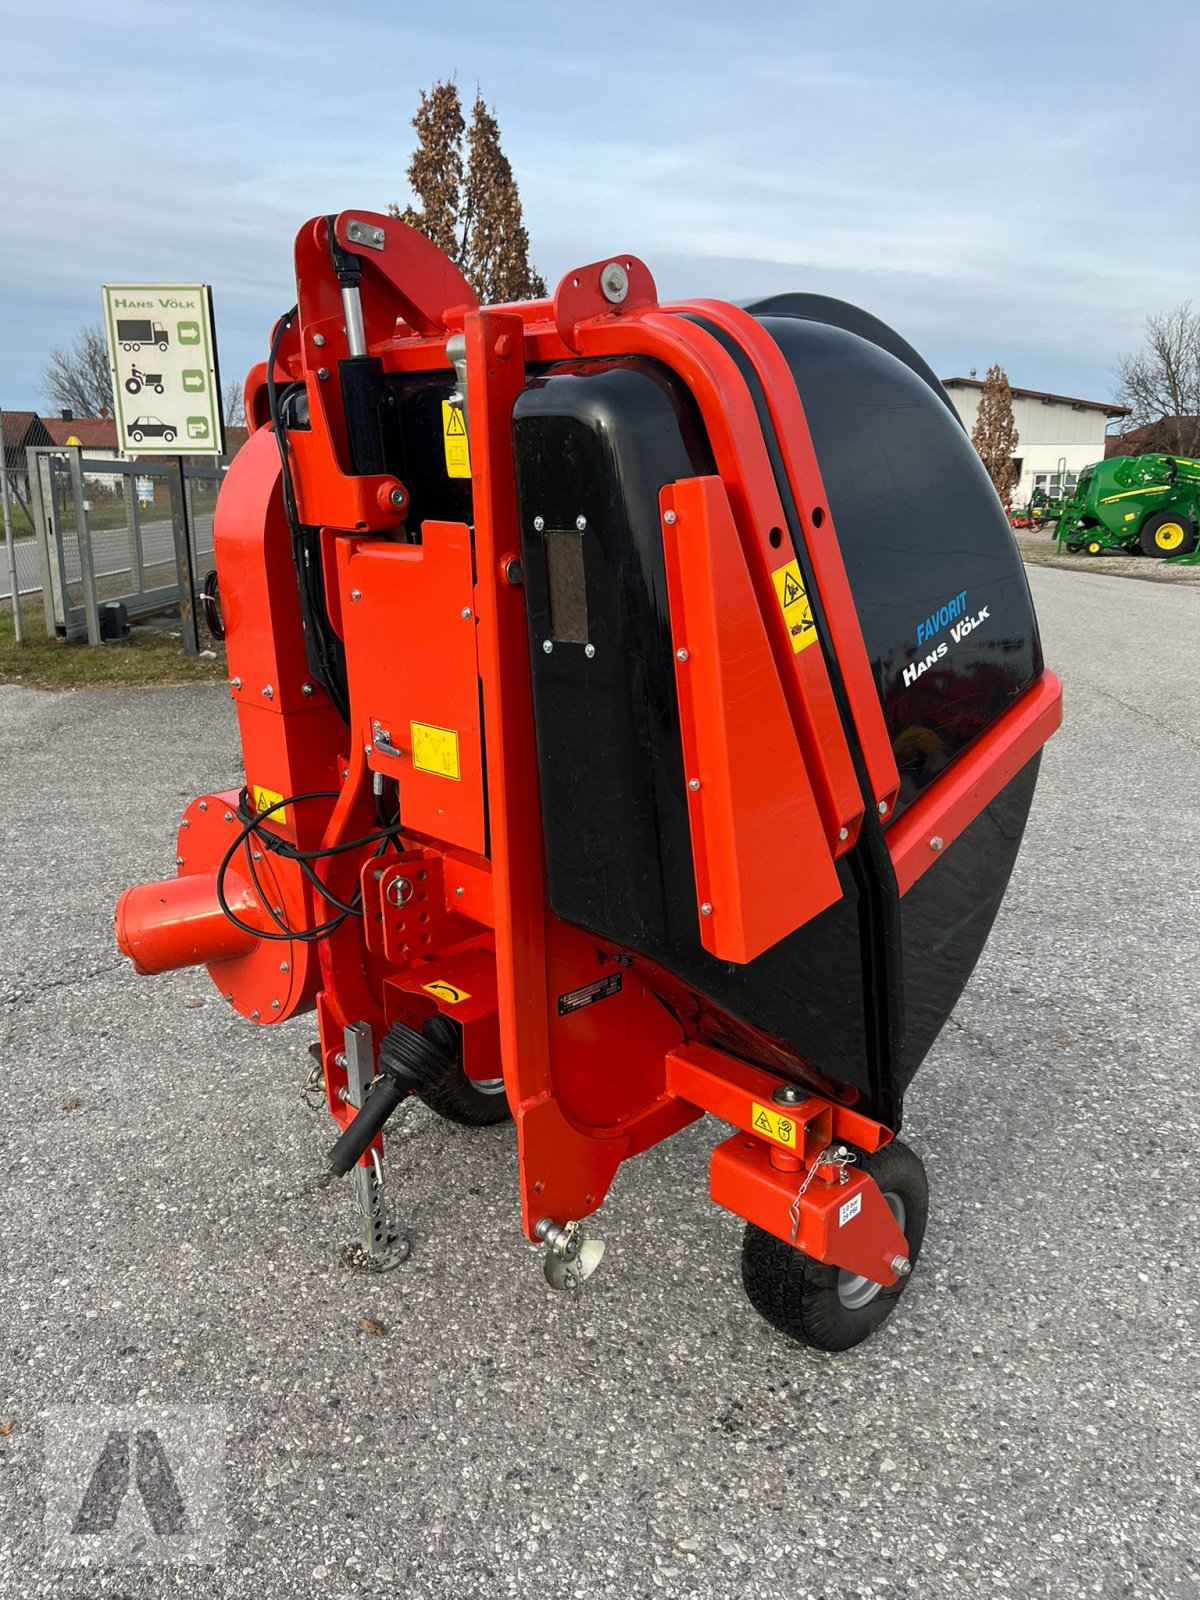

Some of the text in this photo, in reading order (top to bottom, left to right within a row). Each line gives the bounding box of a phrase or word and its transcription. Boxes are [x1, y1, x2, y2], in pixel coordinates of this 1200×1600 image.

[902, 605, 991, 688] HANS VÖLK
[916, 590, 967, 646] FAVORIT
